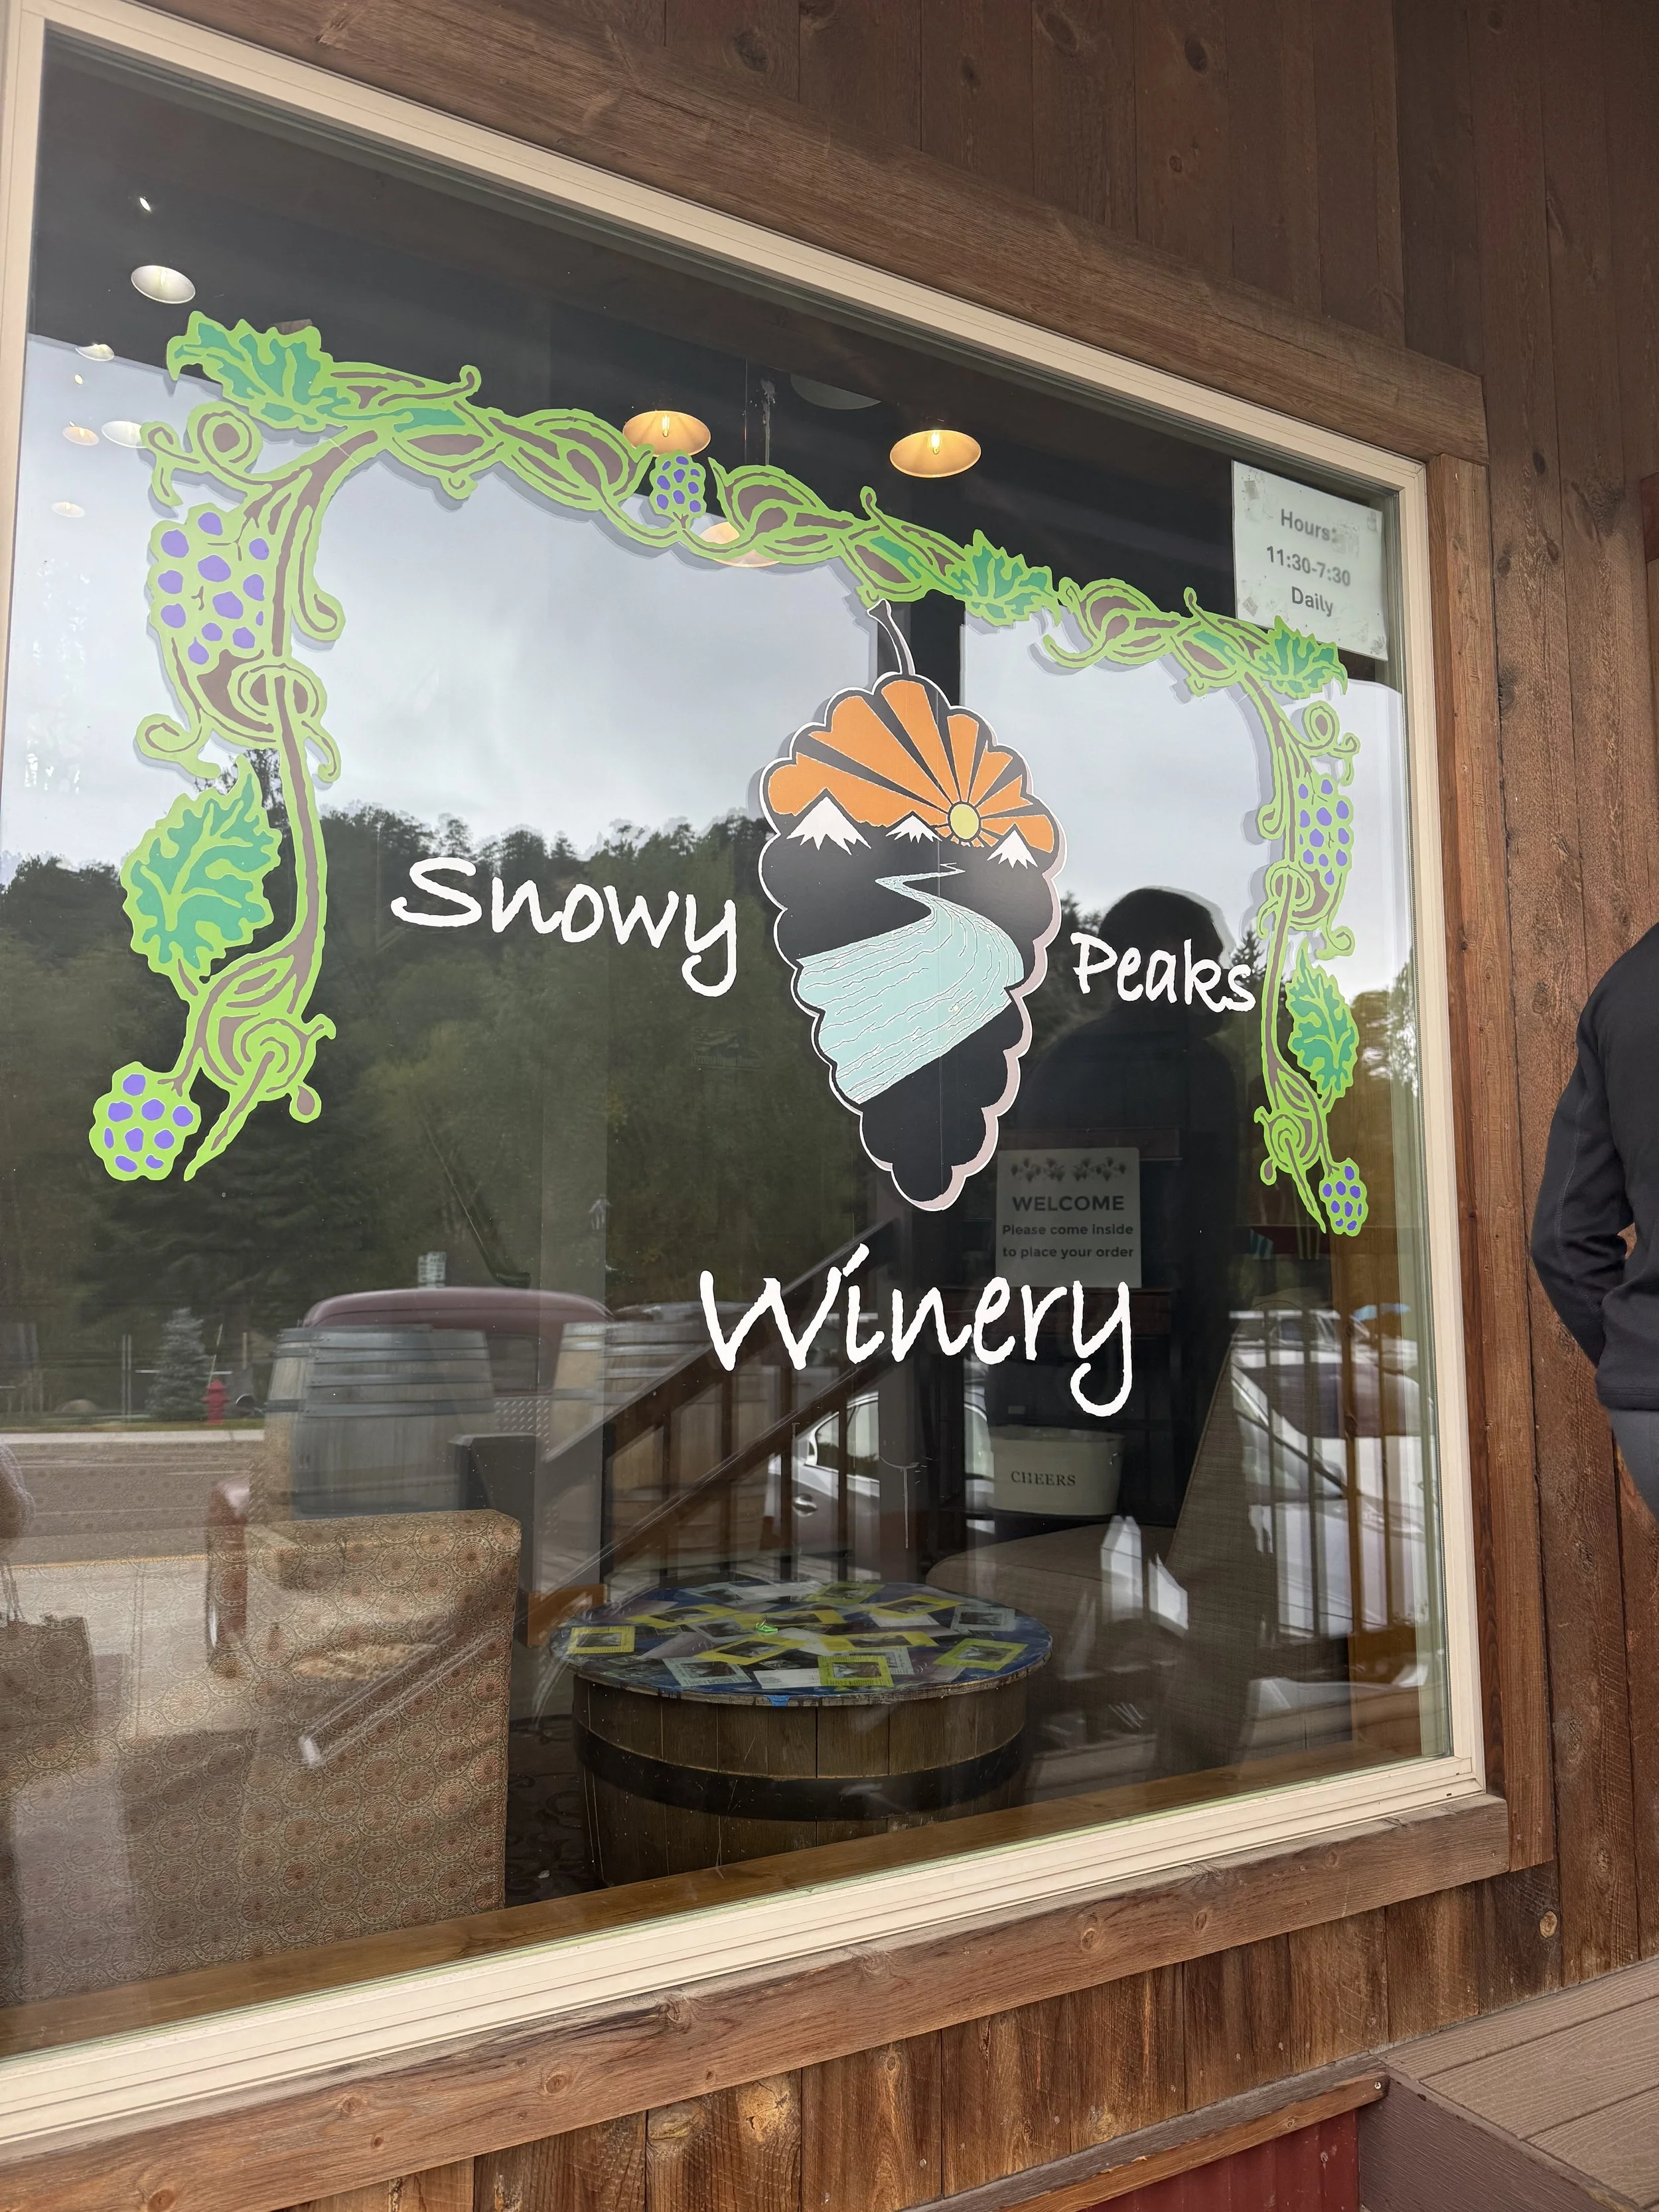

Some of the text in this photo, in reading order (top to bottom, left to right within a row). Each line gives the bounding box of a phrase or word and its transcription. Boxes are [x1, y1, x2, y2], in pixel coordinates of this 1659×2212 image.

[1267, 546, 1350, 587] 11:30-7:30
[1291, 586, 1334, 617] Daily
[390, 856, 1256, 1013] Snowy Peaks
[1012, 1195, 1125, 1211] WELCOME
[1002, 1224, 1134, 1235] Please come inside
[1003, 1246, 1134, 1259] to place your order
[700, 1243, 1133, 1417] Winery
[1011, 1471, 1076, 1487] CHEERS
